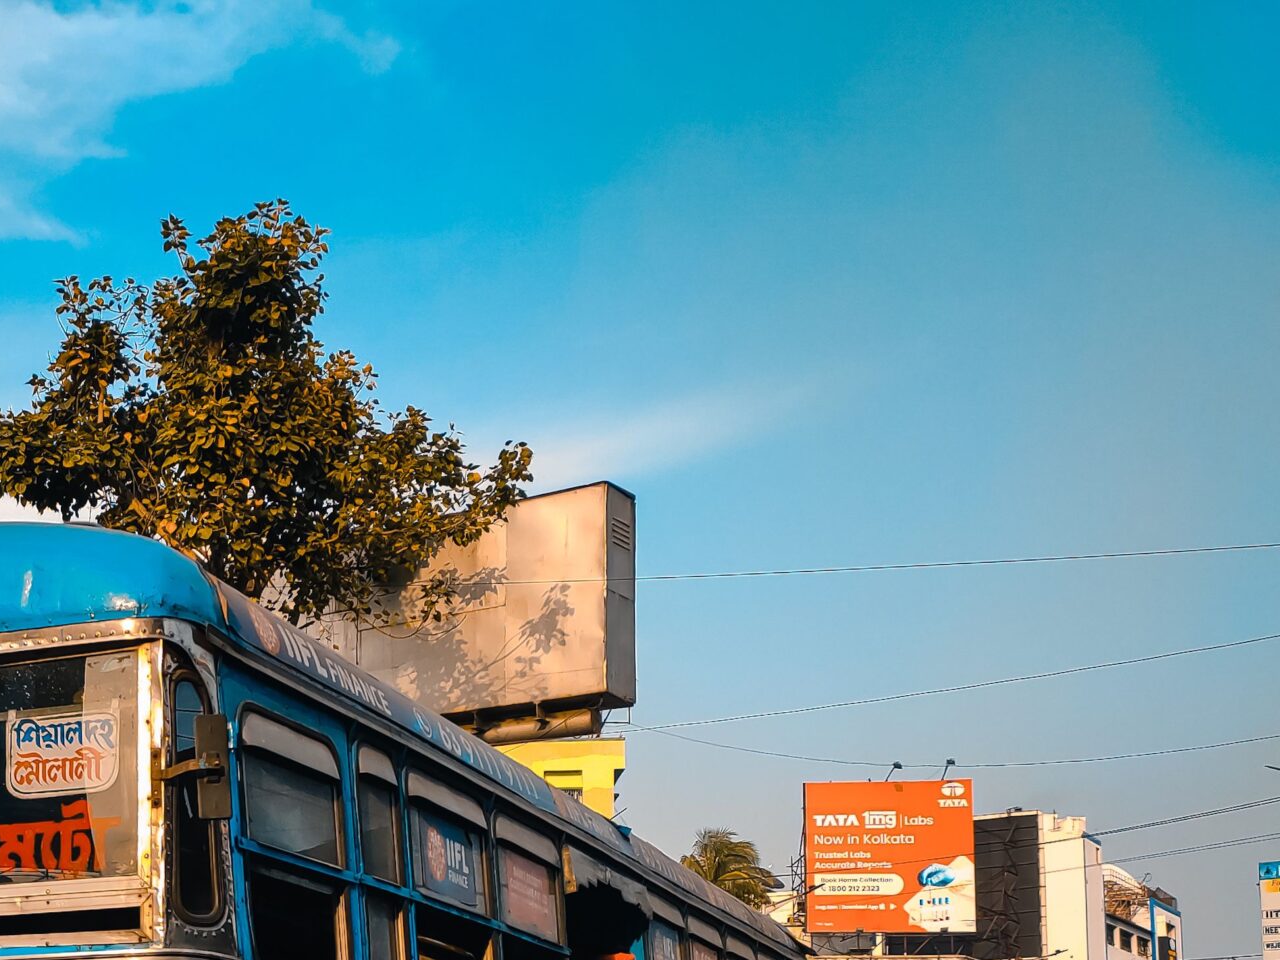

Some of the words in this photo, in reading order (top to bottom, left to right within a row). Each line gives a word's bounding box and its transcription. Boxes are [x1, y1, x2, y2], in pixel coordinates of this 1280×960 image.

[276, 624, 328, 679] IIFL
[328, 661, 392, 717] FINANCE
[13, 746, 107, 786] মৌলালী
[937, 798, 969, 808] TATA
[812, 814, 860, 827] TATA
[861, 810, 897, 829] 1mg
[904, 815, 934, 826] Labs
[814, 834, 844, 845] Now
[847, 834, 860, 845] in
[863, 833, 915, 845] Kolkata
[446, 838, 469, 874] IIFL
[814, 851, 848, 859] Trusted
[849, 851, 871, 859] Labs
[857, 861, 893, 870] Reports
[448, 869, 469, 889] FINANCE
